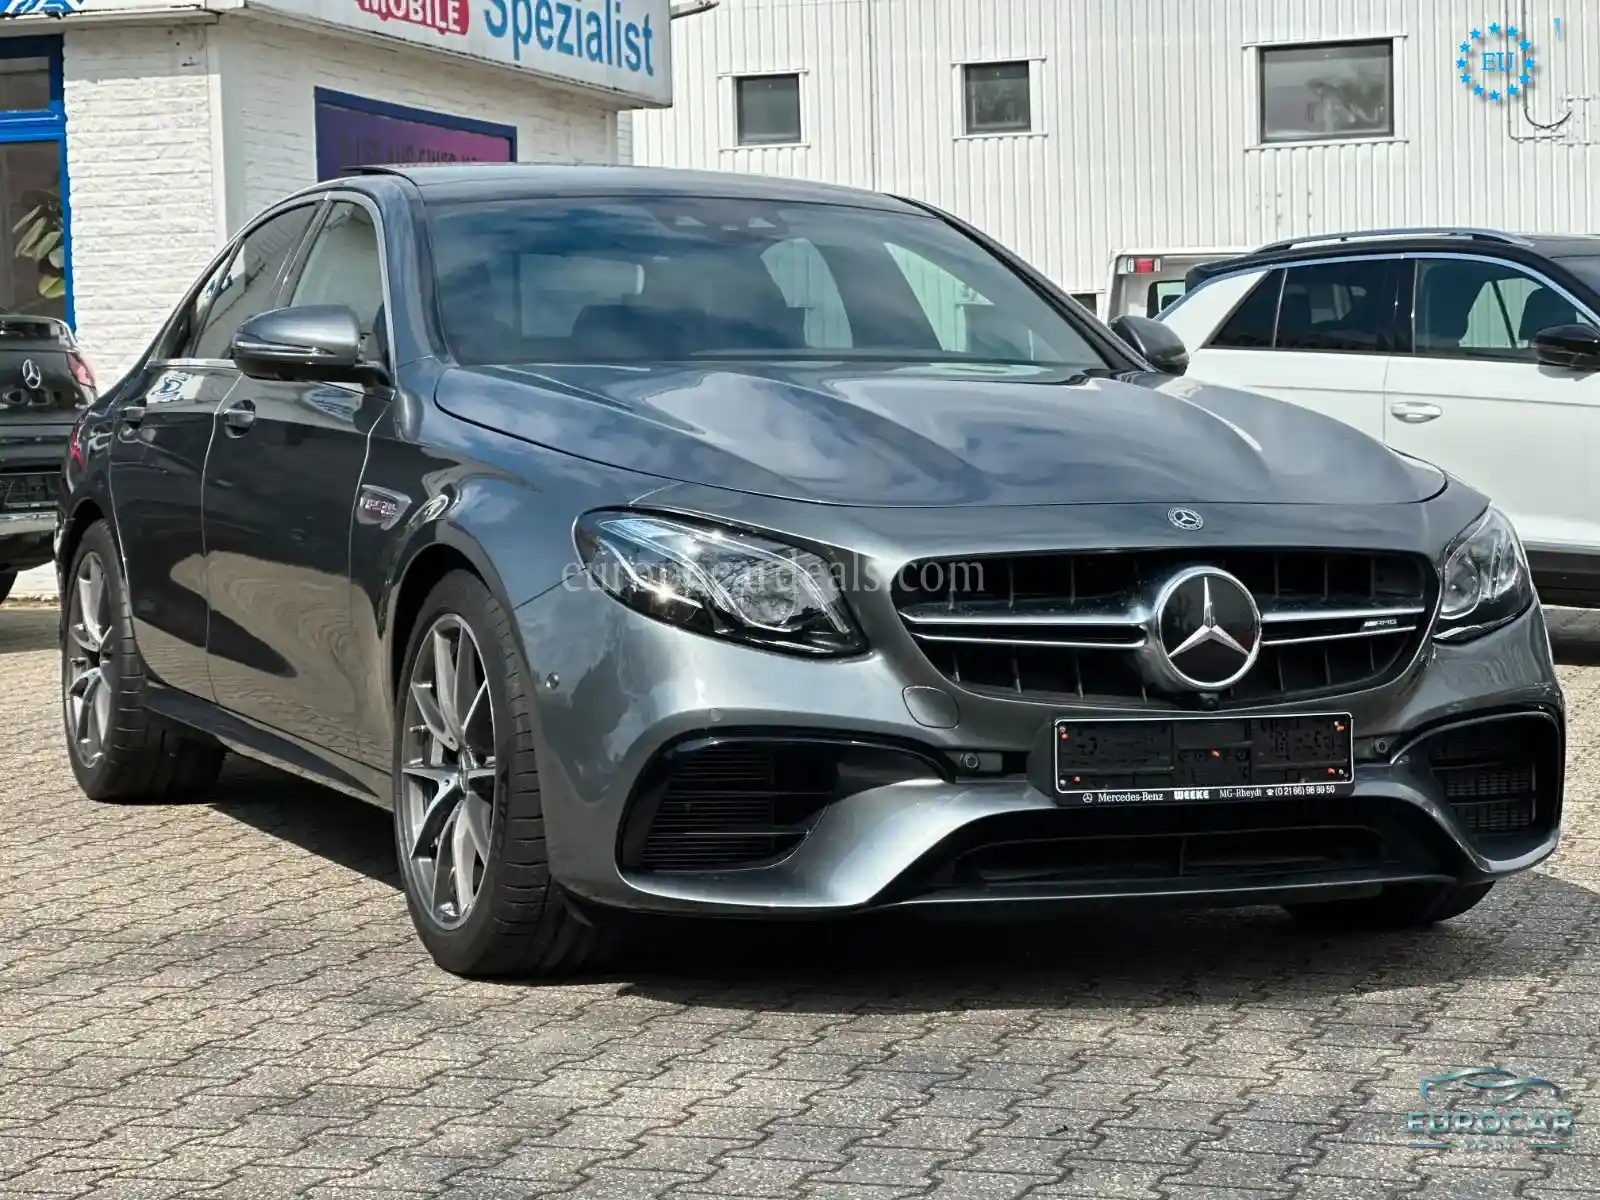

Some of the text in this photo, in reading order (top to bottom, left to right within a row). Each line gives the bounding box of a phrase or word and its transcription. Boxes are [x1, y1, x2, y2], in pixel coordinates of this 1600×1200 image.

[1098, 791, 1164, 802] Mercedes-Benz
[1173, 790, 1210, 800] WEEKE
[1219, 787, 1262, 799] MG-Rheydt
